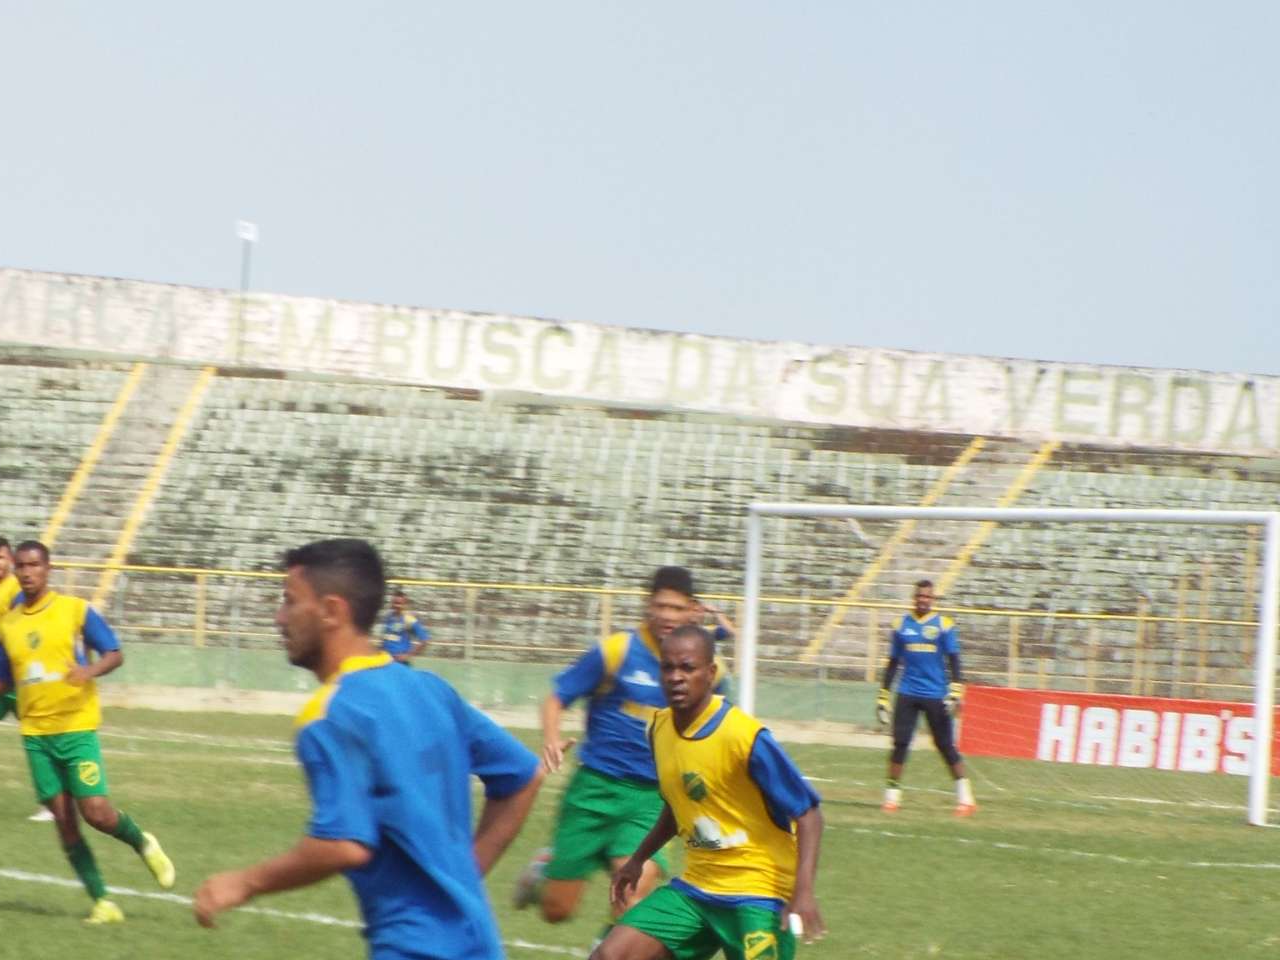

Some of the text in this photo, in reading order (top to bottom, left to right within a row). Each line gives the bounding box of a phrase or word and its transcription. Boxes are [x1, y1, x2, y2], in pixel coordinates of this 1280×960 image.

[227, 301, 335, 364] EM
[373, 309, 628, 394] BUSCA
[665, 341, 760, 406] DA
[806, 354, 954, 420] SUA
[1005, 366, 1280, 450] VERDA
[1036, 703, 1256, 776] HABIB'S
